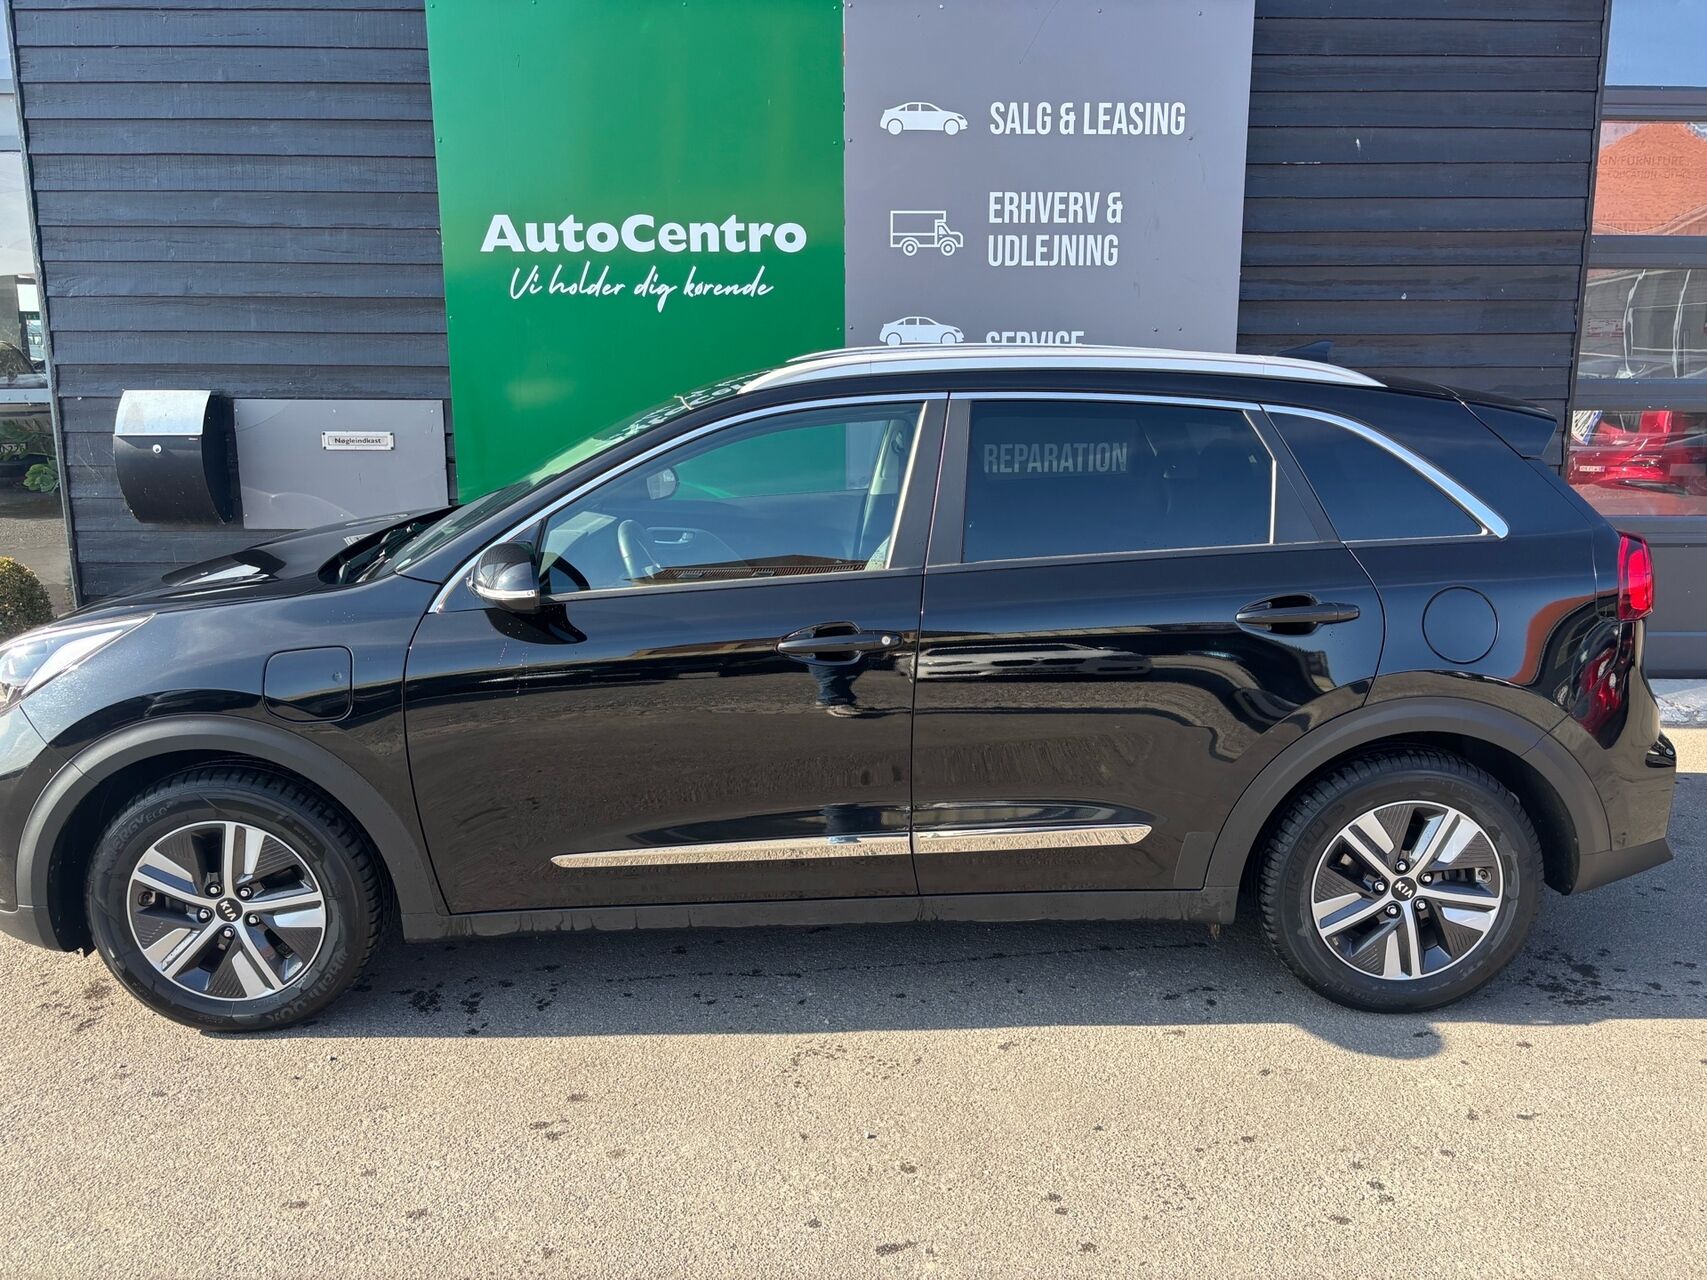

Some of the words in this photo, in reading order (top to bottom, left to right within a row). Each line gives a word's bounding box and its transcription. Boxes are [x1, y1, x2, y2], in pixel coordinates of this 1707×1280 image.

[989, 102, 1052, 135] SALG
[1059, 102, 1076, 135] &
[1083, 102, 1186, 135] LEASING
[988, 191, 1100, 224] ERHVERV
[1106, 191, 1124, 224] &
[480, 214, 807, 253] AutoCentro
[988, 235, 1119, 267] UDLEJNING
[510, 265, 543, 300] Vi
[549, 261, 626, 297] holder
[634, 265, 678, 313] dig
[684, 265, 775, 298] kørende
[334, 437, 381, 445] Nøgleindkast
[983, 442, 1128, 474] REPARATION
[1395, 881, 1413, 898] KIA
[220, 901, 236, 920] KIA
